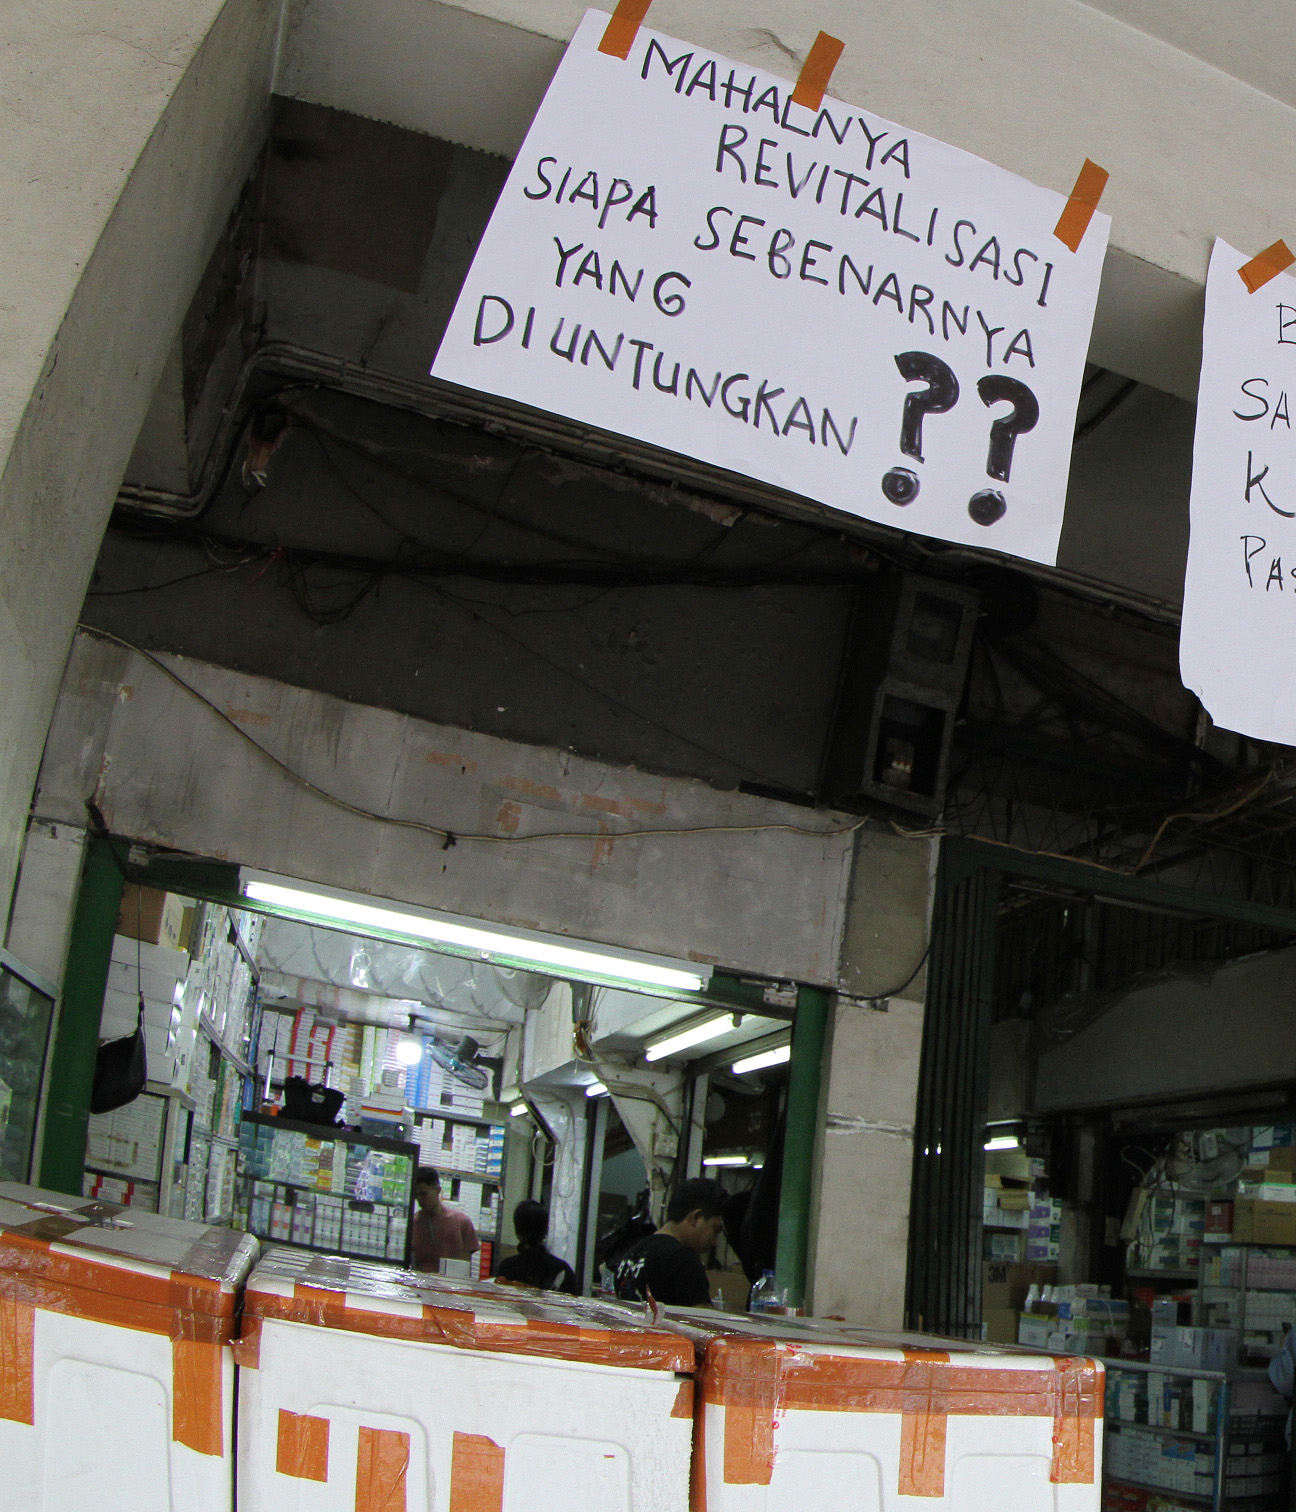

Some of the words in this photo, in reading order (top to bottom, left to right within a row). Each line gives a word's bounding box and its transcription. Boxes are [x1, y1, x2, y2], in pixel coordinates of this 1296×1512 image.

[641, 38, 911, 179] MAHALNYA
[523, 155, 658, 230] SIAPA
[693, 205, 1036, 369] SEBENARNYA
[552, 235, 691, 317] YANG
[715, 123, 1053, 308] REVITALISASI
